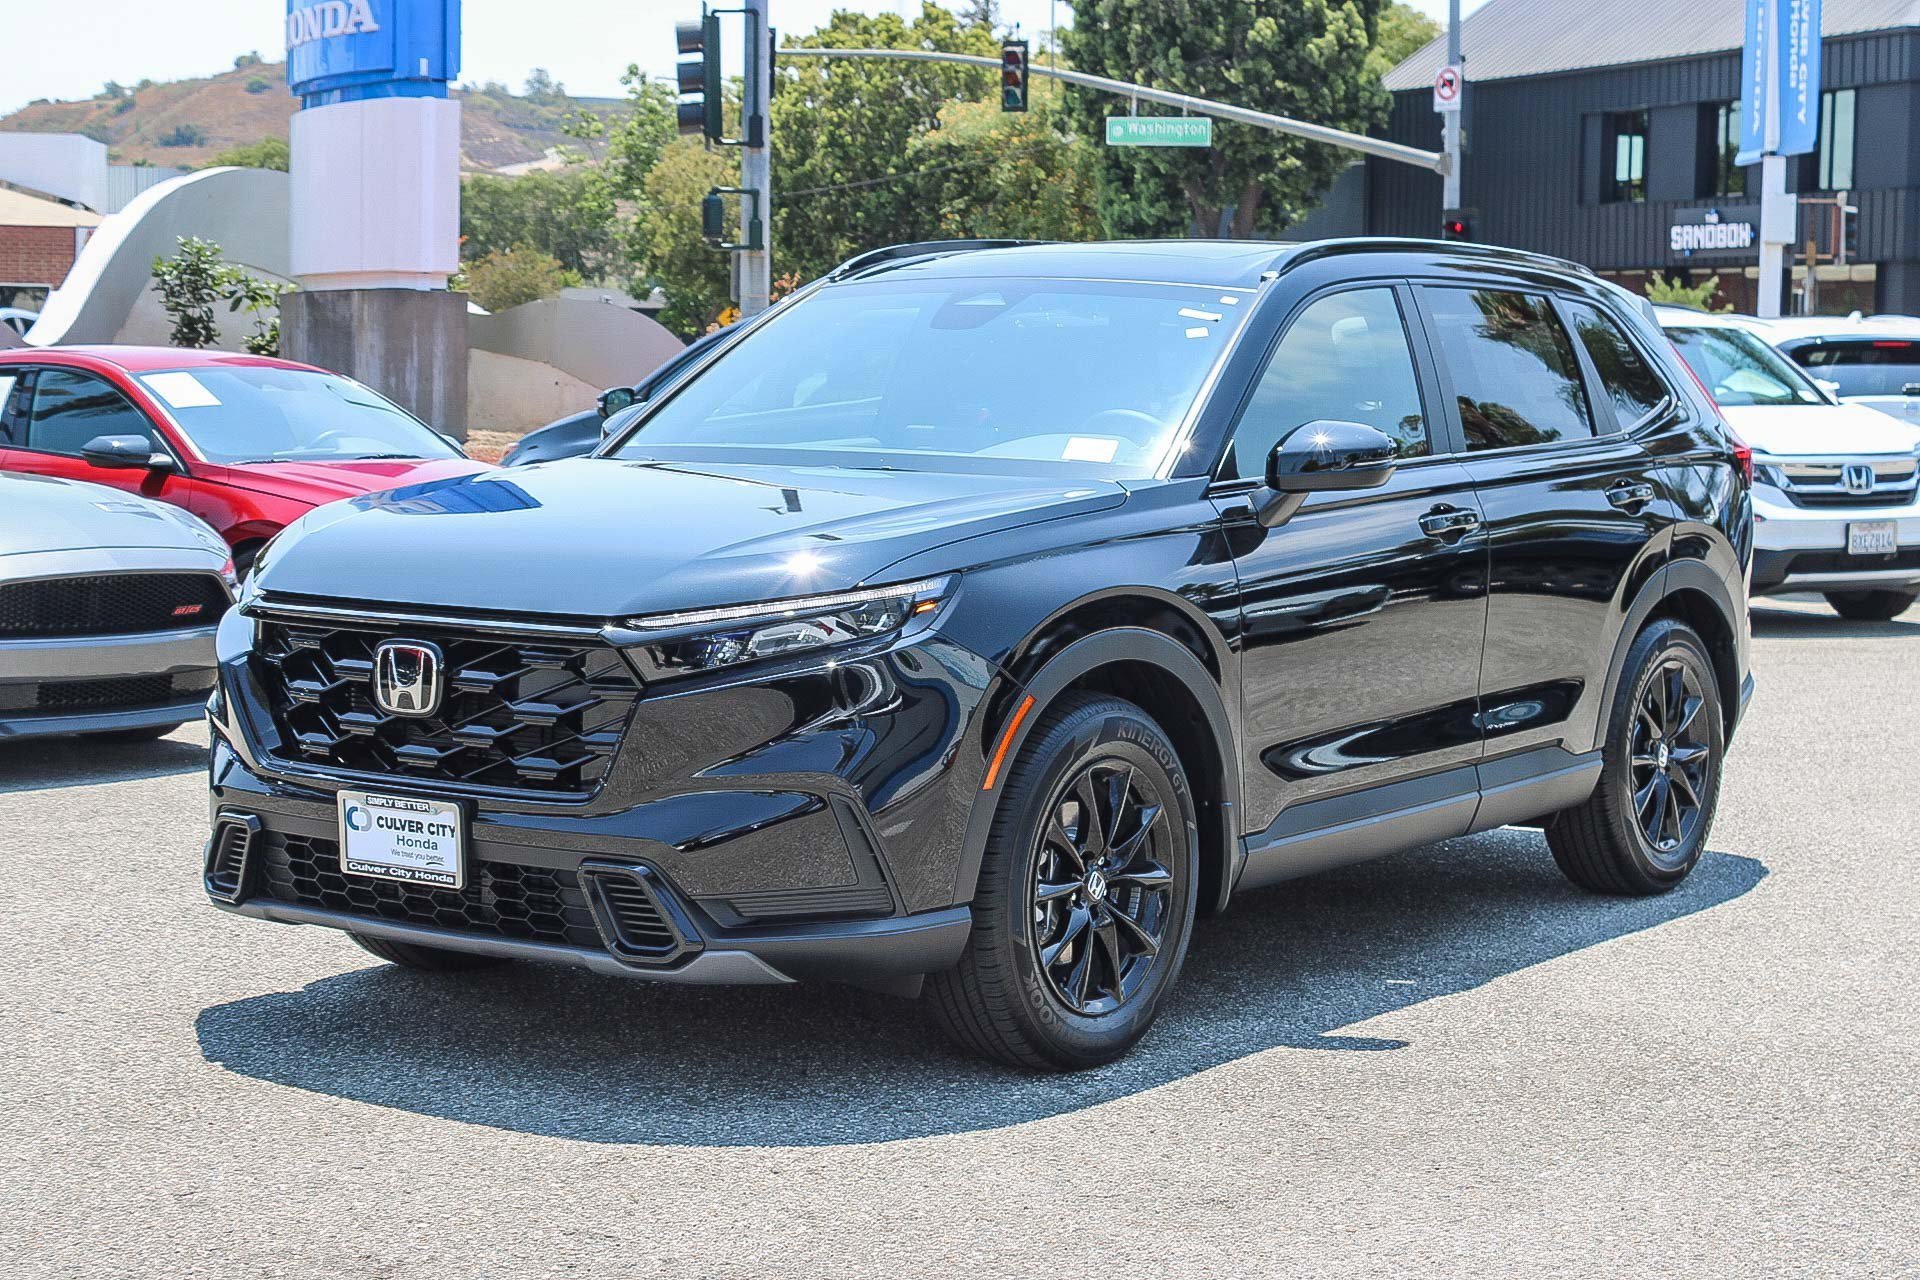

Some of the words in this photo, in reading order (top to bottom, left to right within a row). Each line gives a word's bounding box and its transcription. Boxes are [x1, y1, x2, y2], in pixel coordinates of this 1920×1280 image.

[287, 0, 379, 47] ONDA
[1800, 0, 1809, 57] VER
[1789, 0, 1800, 88] Honda
[1797, 63, 1807, 125] CITY
[1128, 122, 1206, 138] Washington
[1118, 721, 1176, 769] KINERGY
[1173, 773, 1186, 794] GT
[367, 796, 393, 807] SIMPLY
[395, 800, 429, 812] BETTER
[377, 816, 424, 834] CULVER
[427, 823, 456, 838] CITY
[396, 835, 438, 850] Honda
[415, 853, 425, 861] you
[349, 862, 387, 875] Culver
[389, 867, 412, 879] City
[415, 871, 454, 883] Honda
